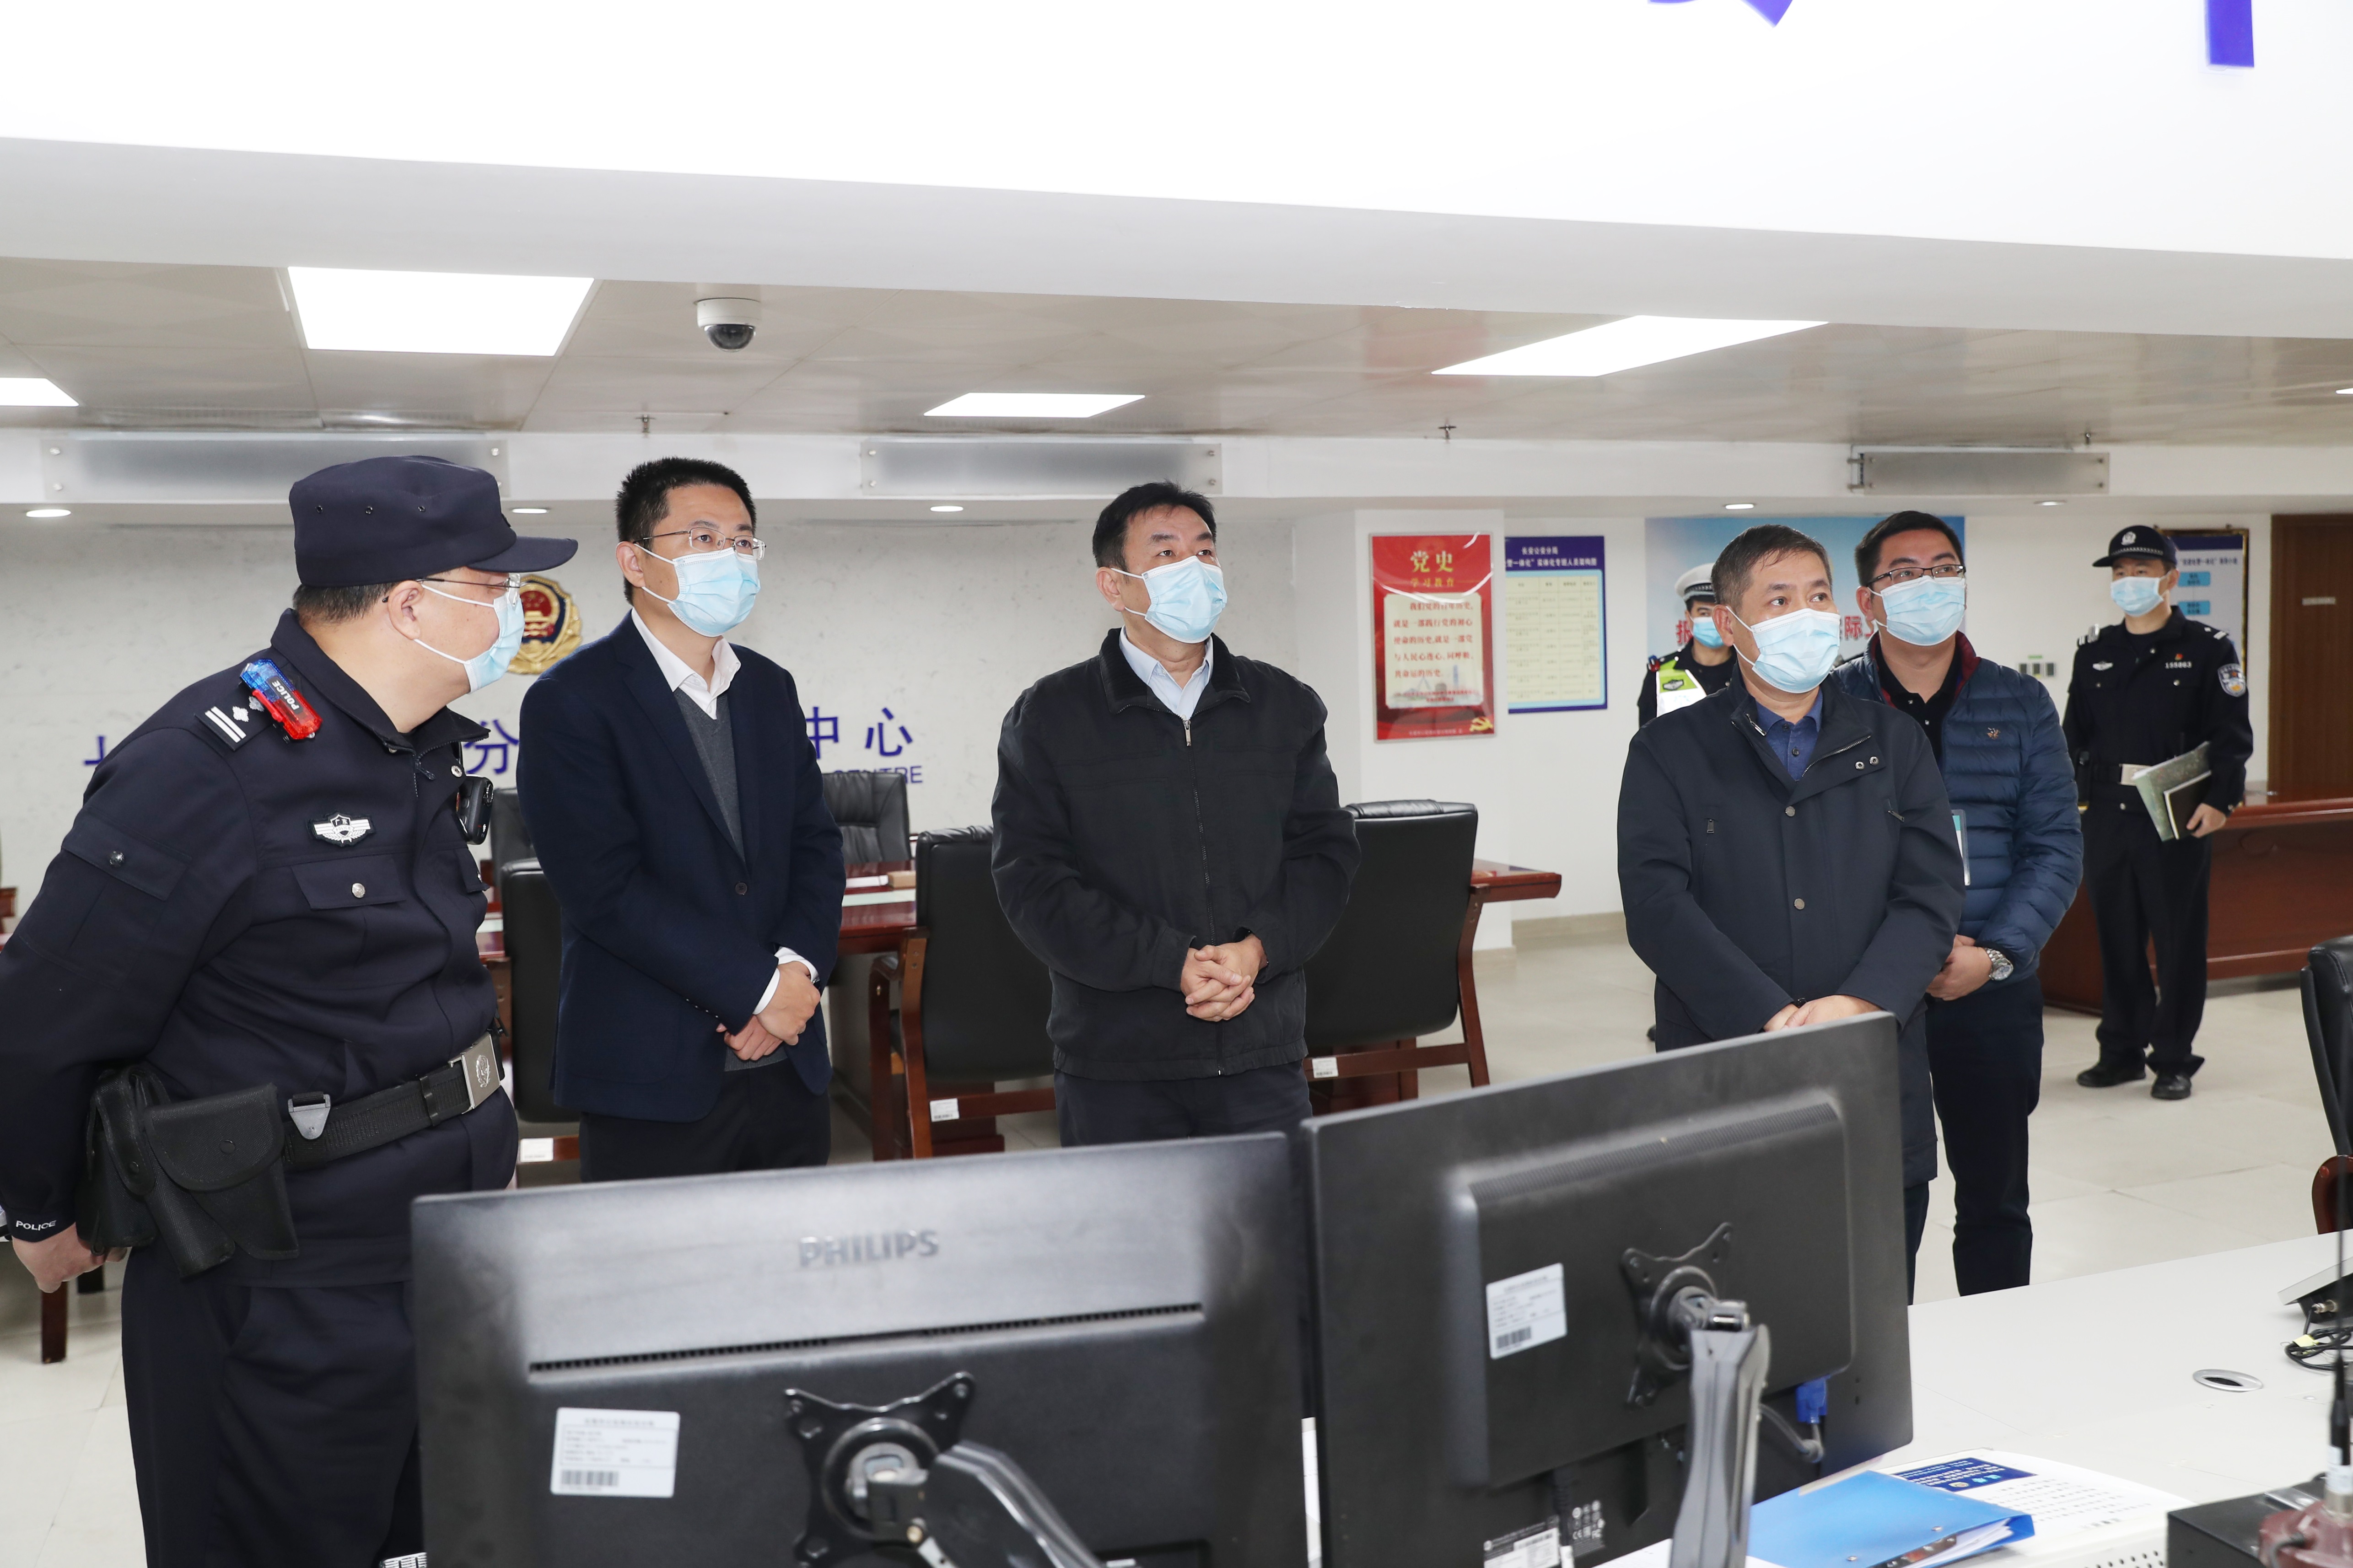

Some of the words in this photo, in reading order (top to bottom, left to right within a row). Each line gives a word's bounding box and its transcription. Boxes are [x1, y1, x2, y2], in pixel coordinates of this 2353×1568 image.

[1410, 550, 1453, 572] 党史
[1411, 577, 1454, 587] 学习教育
[1393, 618, 1473, 628] 就是一部践行党的初心
[1845, 616, 1862, 639] 际
[272, 680, 300, 710] POLICE
[463, 720, 519, 774] 分
[805, 707, 913, 759] 中心
[16, 1220, 57, 1231] POLICE
[799, 1229, 939, 1267] PHILIPS
